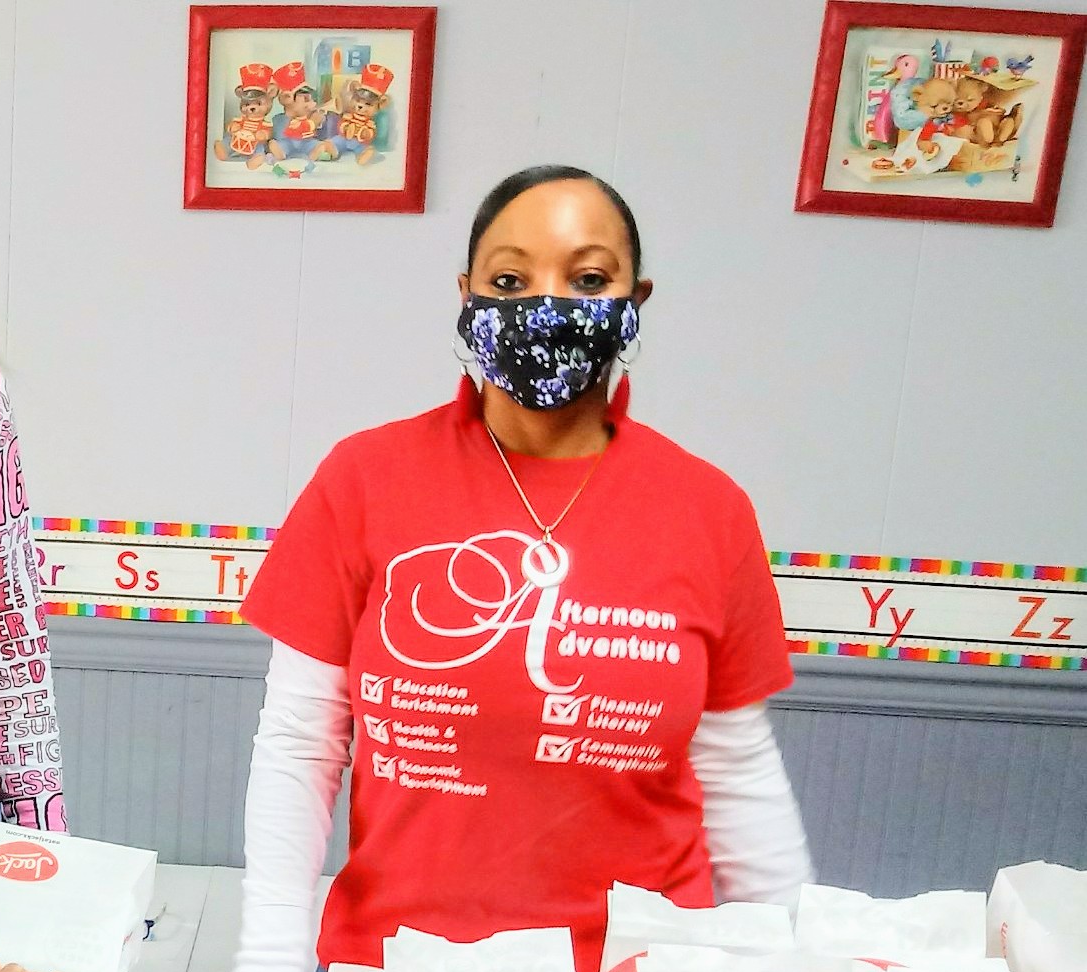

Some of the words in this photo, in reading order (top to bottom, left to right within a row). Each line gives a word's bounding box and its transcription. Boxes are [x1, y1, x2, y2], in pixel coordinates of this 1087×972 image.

[35, 547, 66, 586] Rr
[114, 550, 160, 592] Ss
[210, 554, 249, 595] Tt
[861, 586, 915, 648] Yy
[1010, 596, 1074, 640] Zz
[392, 677, 469, 700] Education
[390, 694, 479, 717] Enrichment
[589, 694, 664, 719] Financial
[580, 737, 664, 761] Community
